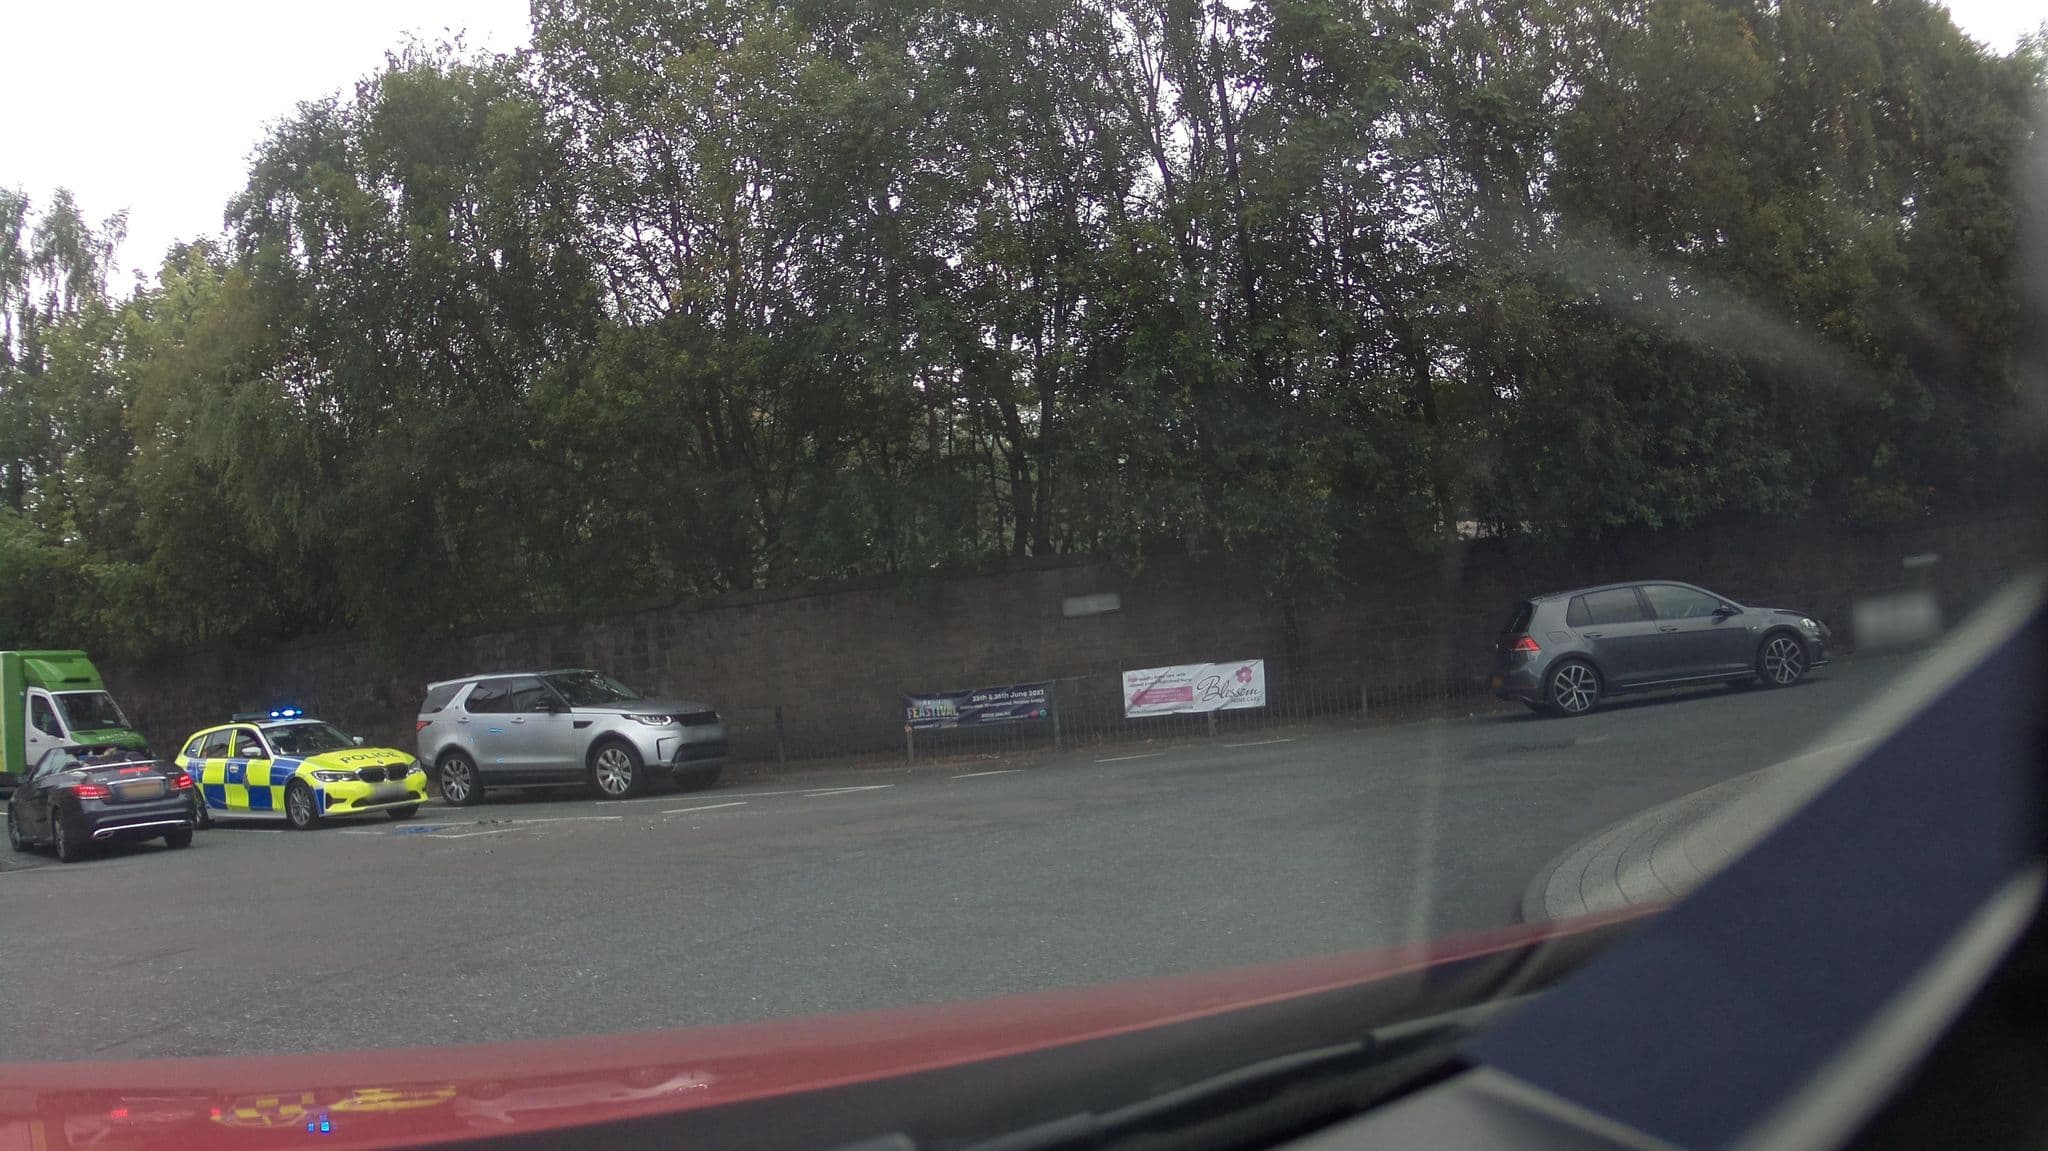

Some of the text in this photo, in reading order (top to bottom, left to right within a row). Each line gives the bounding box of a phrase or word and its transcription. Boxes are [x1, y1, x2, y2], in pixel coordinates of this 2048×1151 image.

[1010, 690, 1027, 698] June
[1196, 675, 1259, 702] Blossom
[906, 704, 959, 719] FEASTIVAL
[340, 752, 401, 764] POLICE
